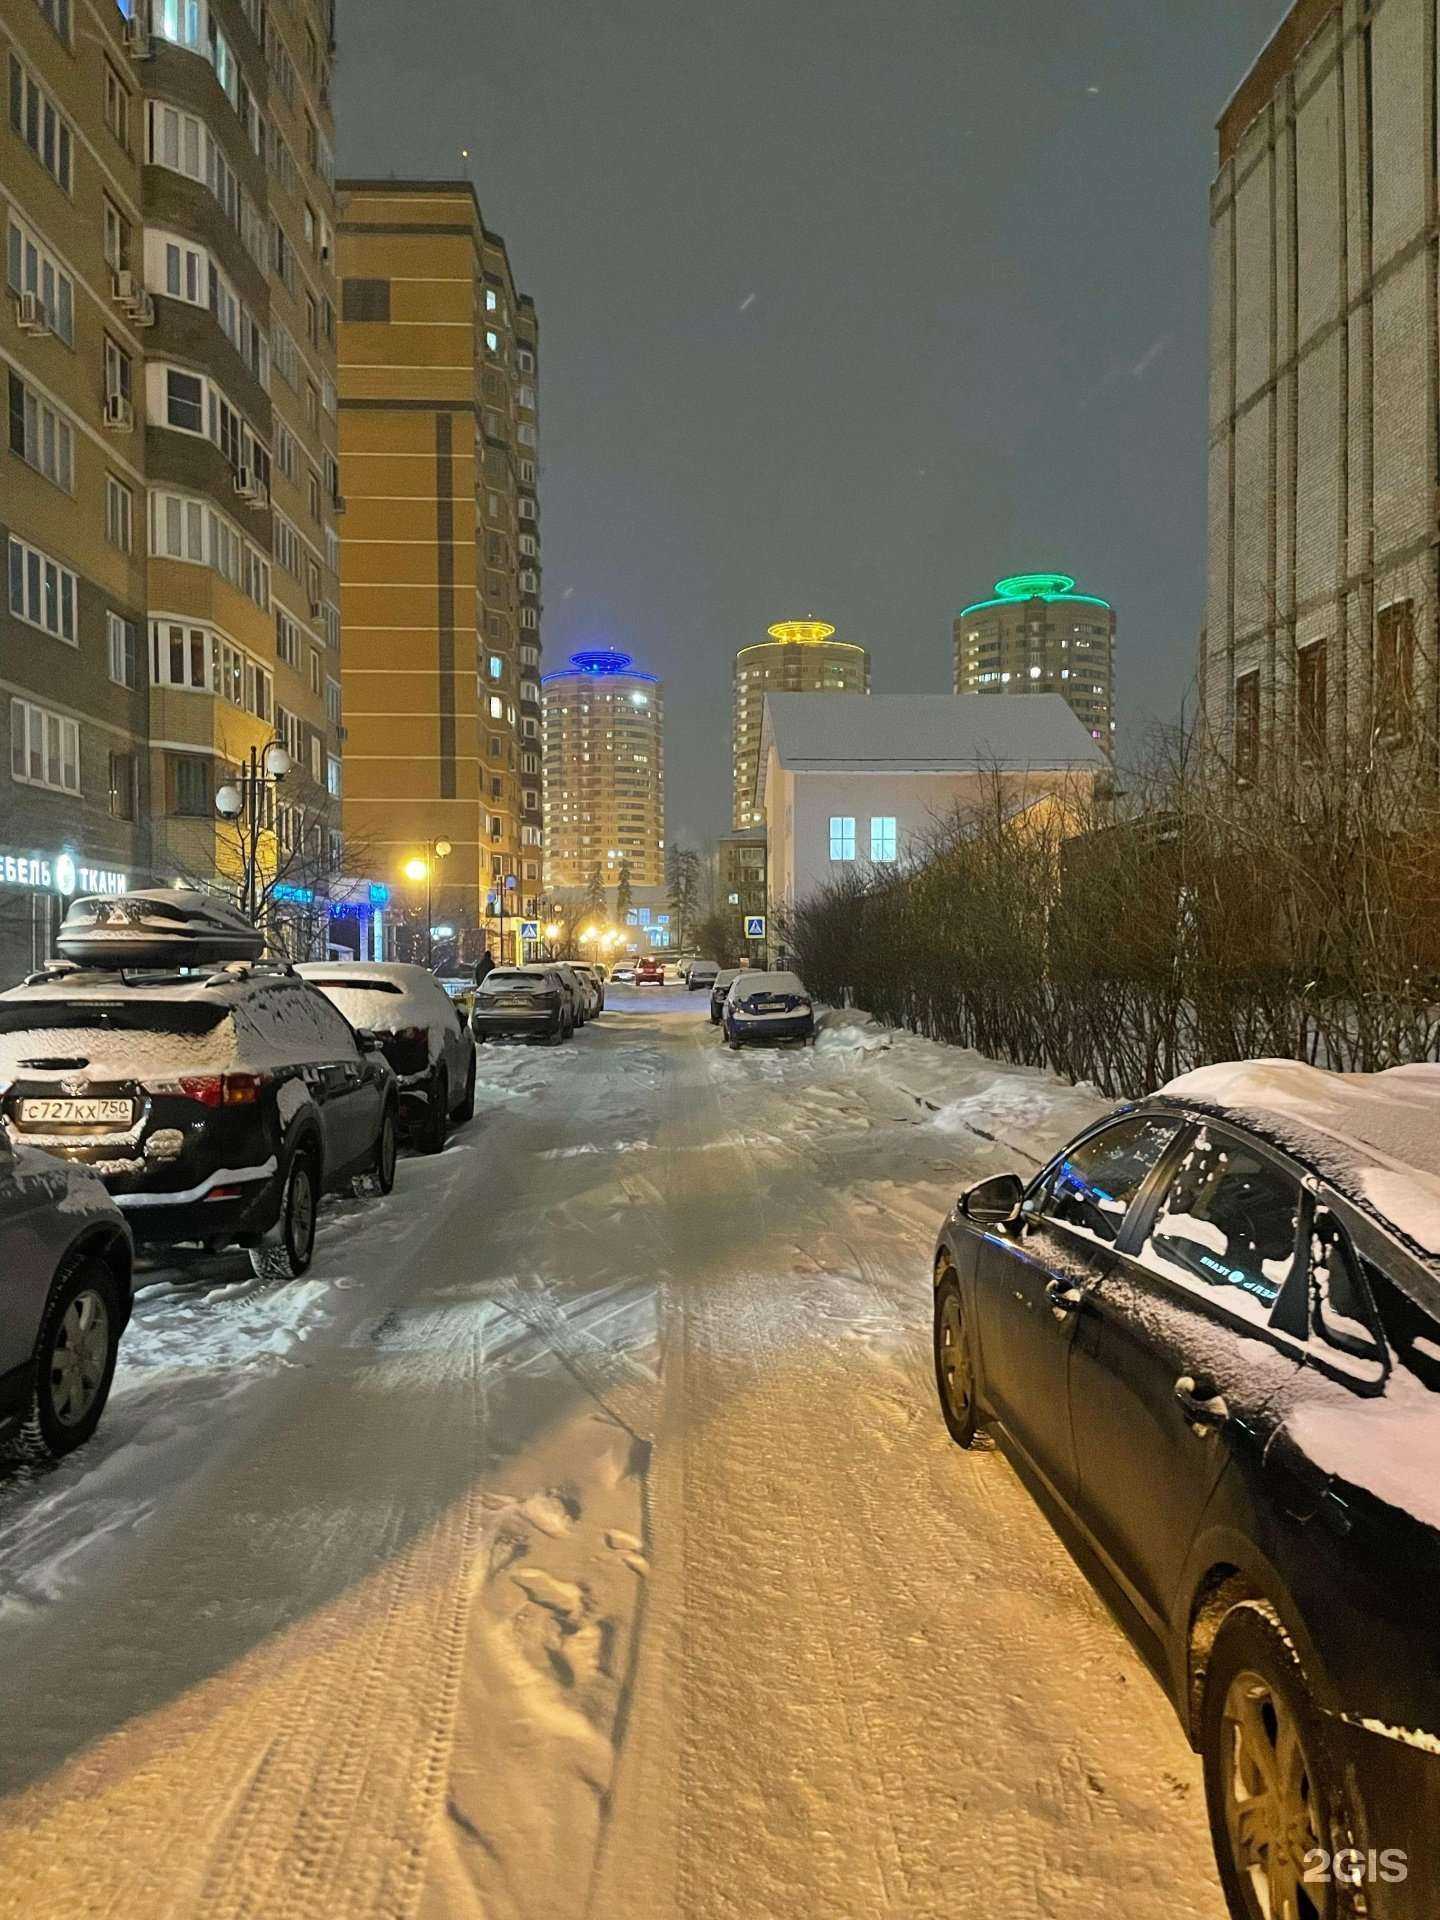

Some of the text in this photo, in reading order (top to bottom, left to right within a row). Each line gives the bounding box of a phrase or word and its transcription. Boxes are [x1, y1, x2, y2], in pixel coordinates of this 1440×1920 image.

[79, 867, 127, 894] ТКАНИ
[28, 1100, 128, 1119] С727КХ 750
